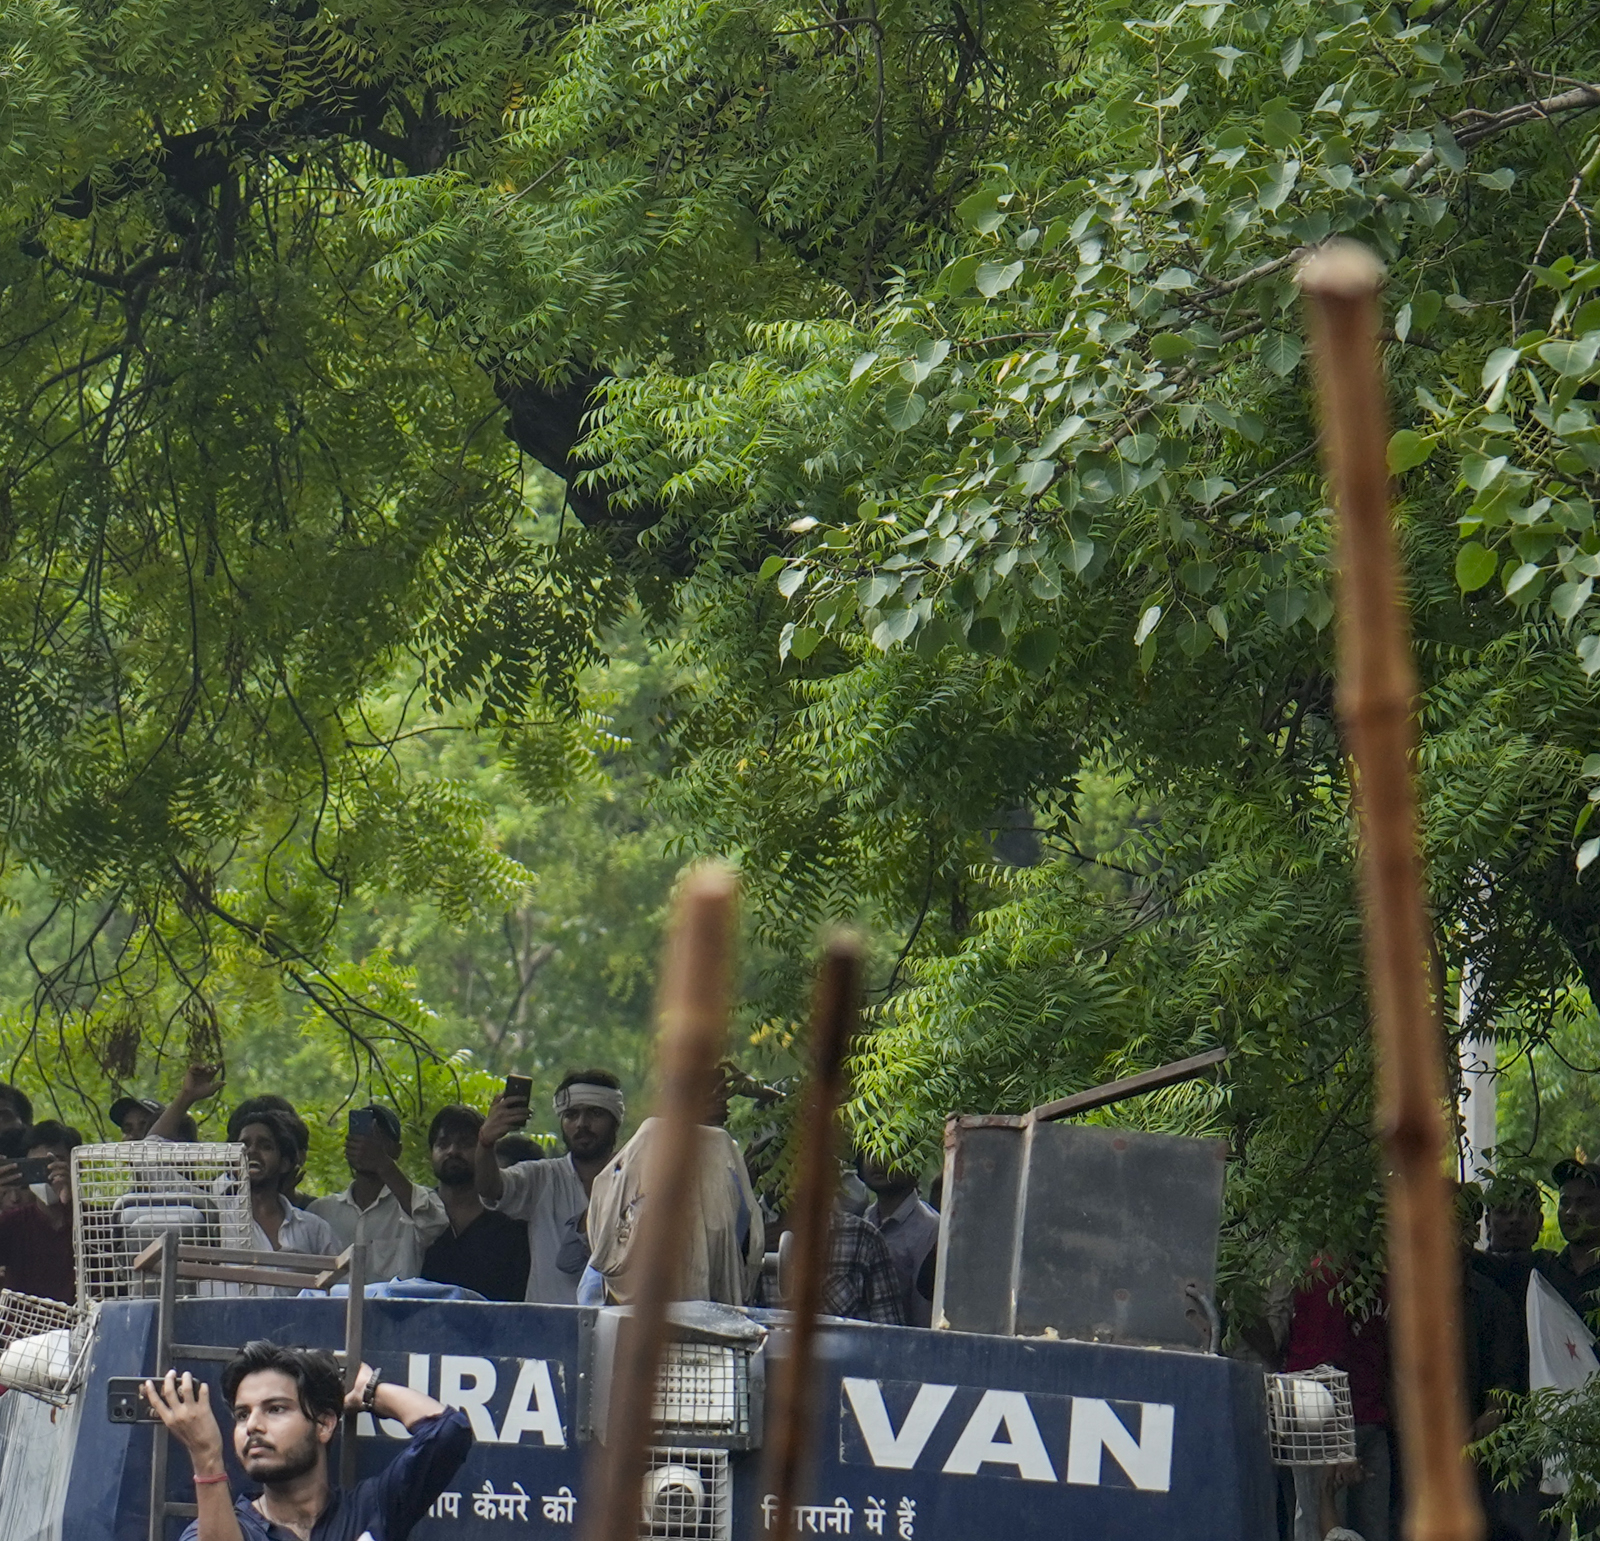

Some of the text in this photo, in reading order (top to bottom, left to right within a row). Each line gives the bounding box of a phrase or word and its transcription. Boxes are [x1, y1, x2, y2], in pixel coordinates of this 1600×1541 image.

[842, 1376, 1175, 1492] VAN
[472, 1479, 531, 1522] कैमरे
[542, 1486, 577, 1524] की
[864, 1496, 887, 1536] में
[897, 1496, 918, 1541] हैं
